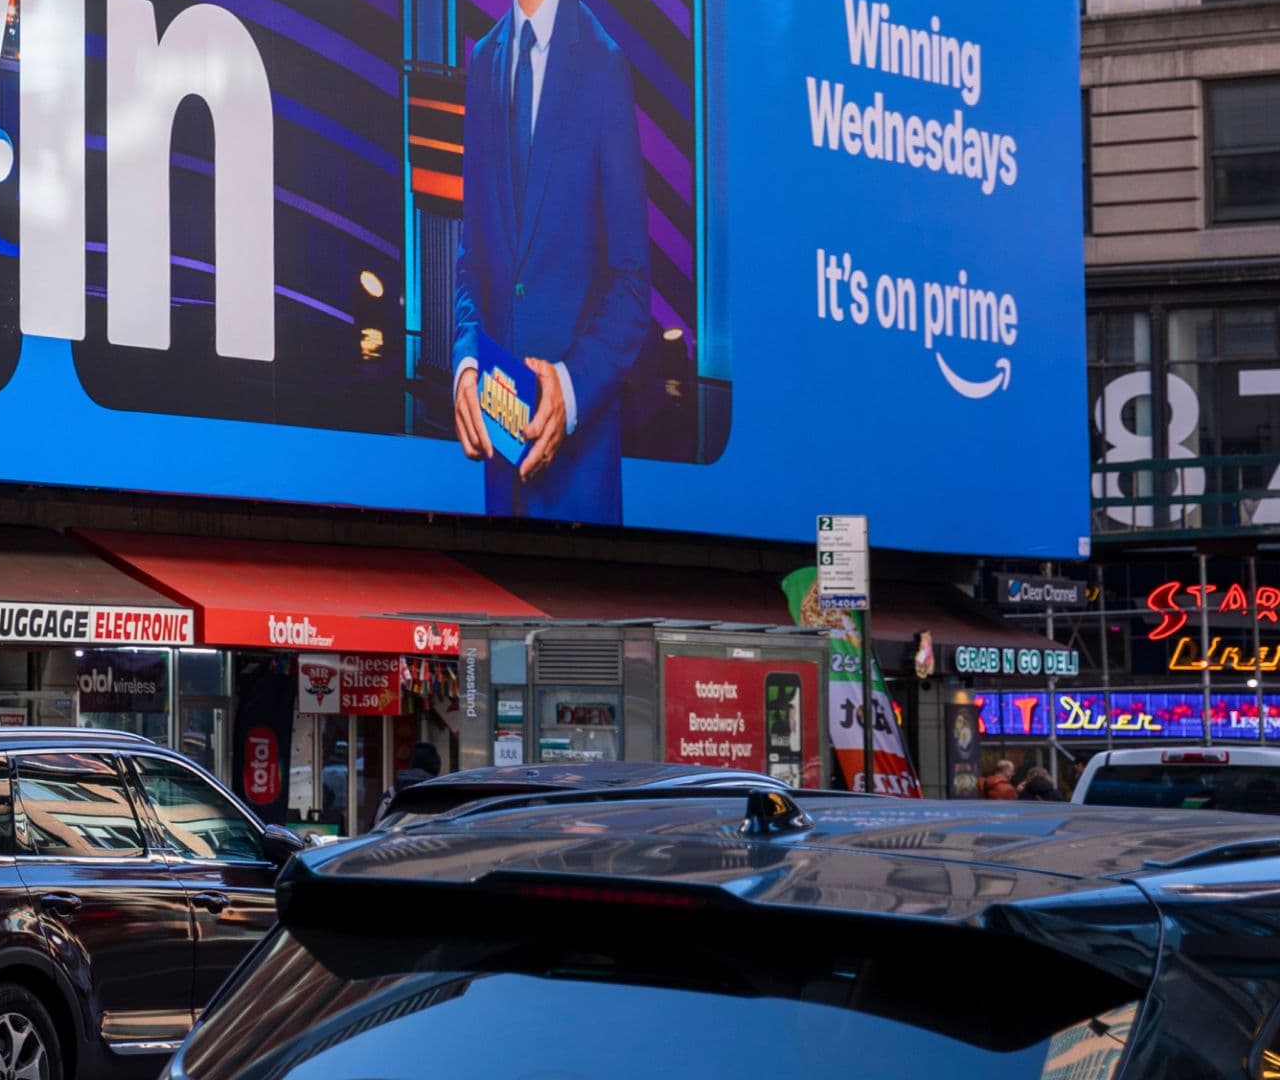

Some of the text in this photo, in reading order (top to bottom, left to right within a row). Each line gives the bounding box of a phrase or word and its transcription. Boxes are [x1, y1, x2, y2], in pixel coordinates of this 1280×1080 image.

[806, 76, 1018, 195] Wednesdays
[816, 248, 1018, 349] It's on prime
[821, 517, 831, 530] 2
[822, 552, 831, 565] 6
[1020, 582, 1078, 603] Clear Channel
[95, 610, 189, 643] ELECTRONIC
[268, 614, 310, 645] total
[343, 655, 399, 672] Cheese
[955, 645, 1000, 673] GRAB
[1017, 648, 1041, 674] GO
[1043, 649, 1079, 676] DELI
[77, 666, 157, 694] otal wireless
[343, 671, 389, 689] Slices
[466, 647, 478, 718] Newsstand
[342, 693, 379, 709] $1.50
[689, 712, 745, 735] Broadway's
[680, 738, 753, 761] best tix at your
[248, 736, 271, 794] total
